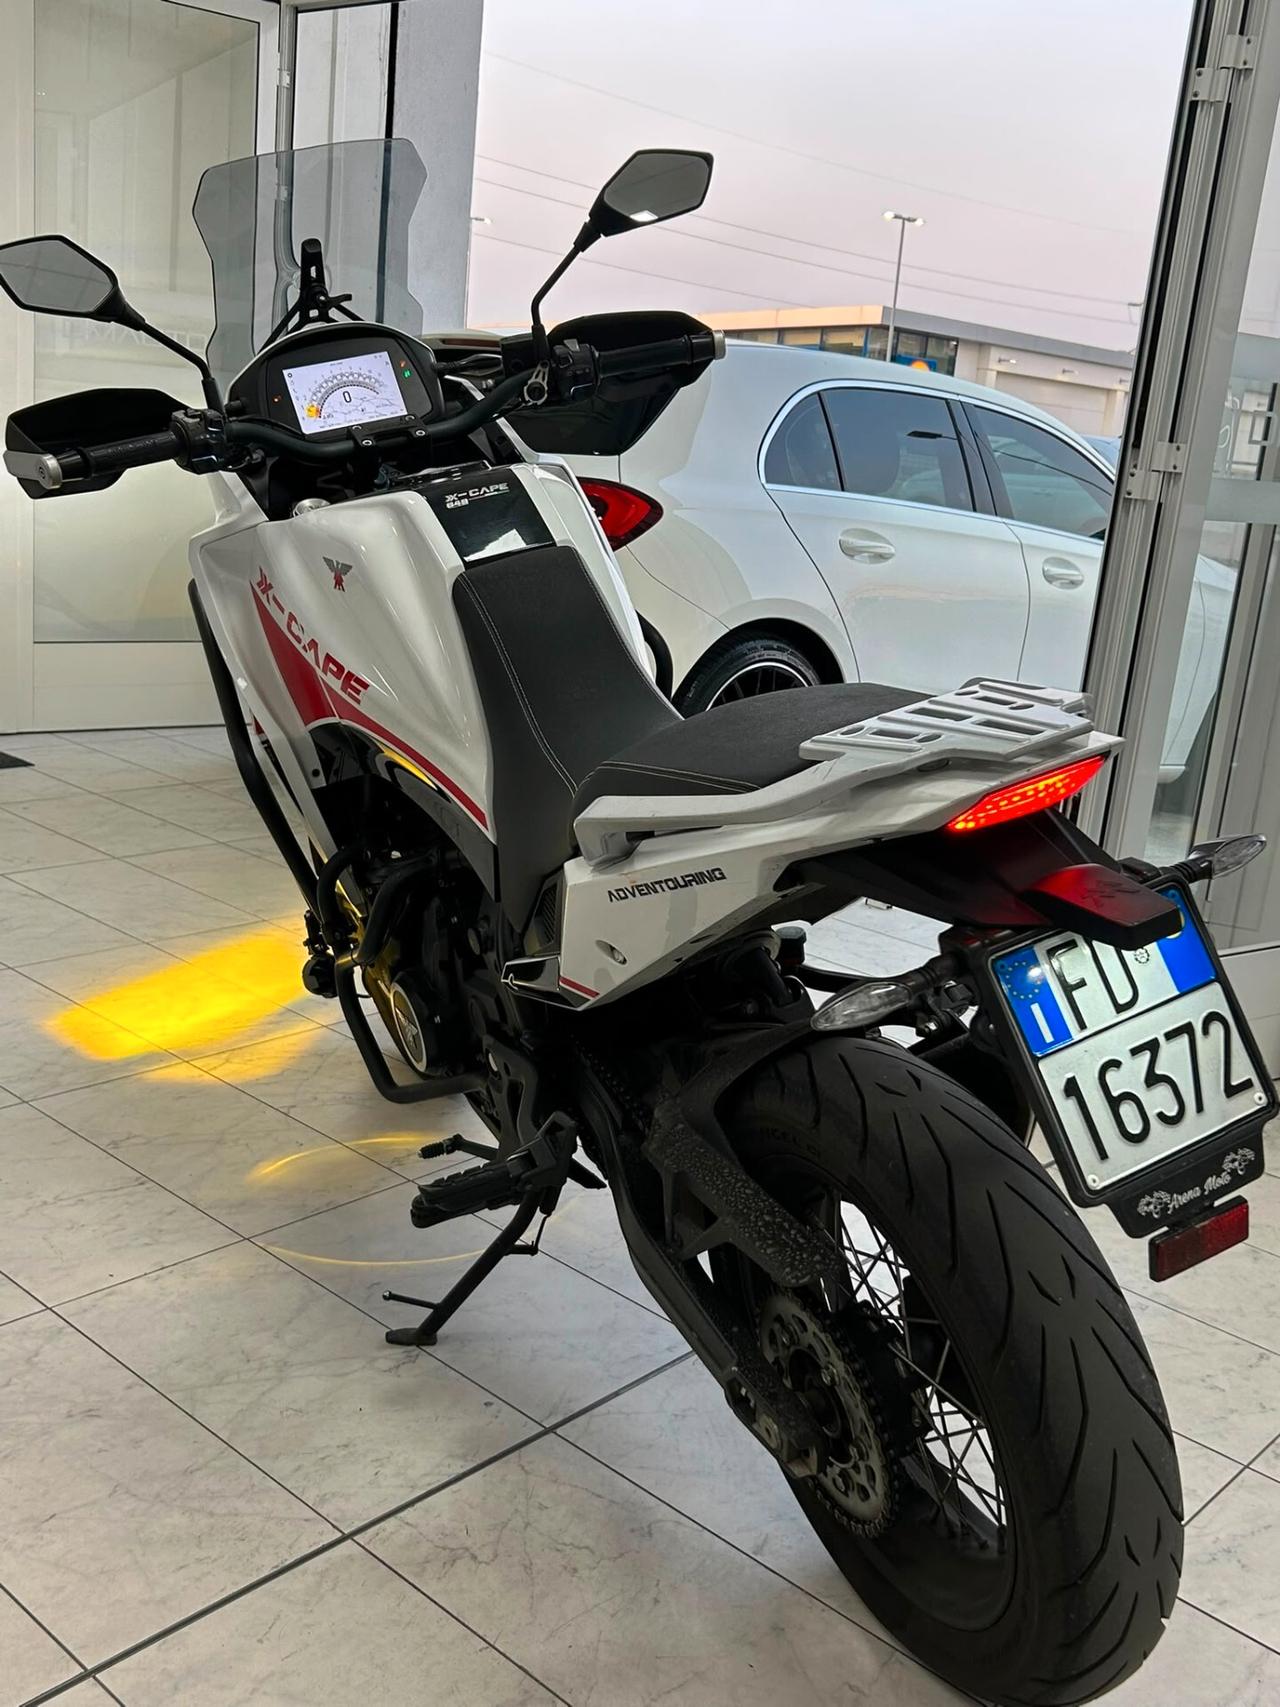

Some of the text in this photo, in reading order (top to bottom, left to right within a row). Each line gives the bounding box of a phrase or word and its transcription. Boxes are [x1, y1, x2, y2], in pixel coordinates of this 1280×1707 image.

[445, 482, 509, 502] X-CAPE
[257, 565, 370, 705] X-CAPE
[607, 867, 727, 902] ADVENTOURING
[1047, 937, 1140, 1031] FD
[1063, 1010, 1254, 1161] 16372
[1167, 1170, 1232, 1215] Arena Moto
